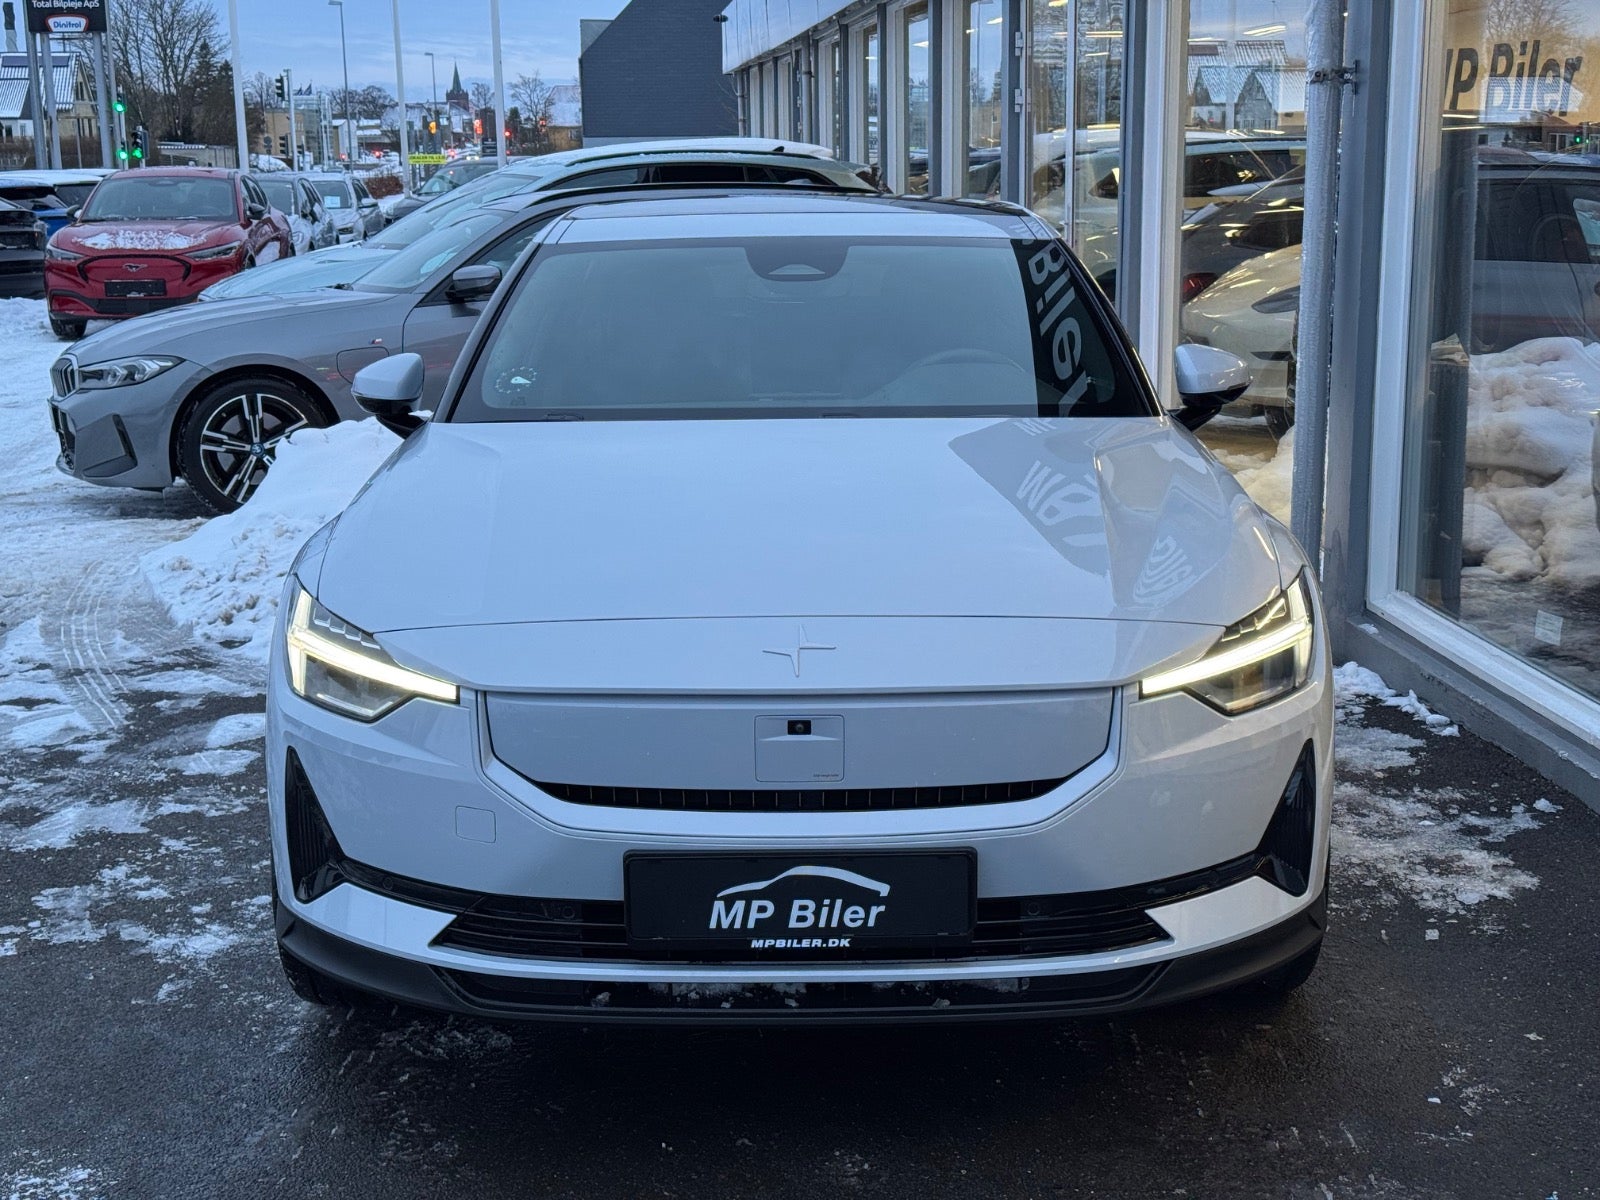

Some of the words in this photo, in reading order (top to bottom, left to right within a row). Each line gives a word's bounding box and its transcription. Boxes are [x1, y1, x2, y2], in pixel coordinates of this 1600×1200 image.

[32, 0, 52, 8] Total
[53, 0, 83, 9] Bilpleje
[83, 0, 100, 9] ApS
[53, 21, 82, 29] Dinitrol
[1485, 40, 1583, 117] Biler
[709, 900, 776, 929] MP
[788, 899, 886, 929] Biler
[751, 938, 851, 949] MPBILER.DK
